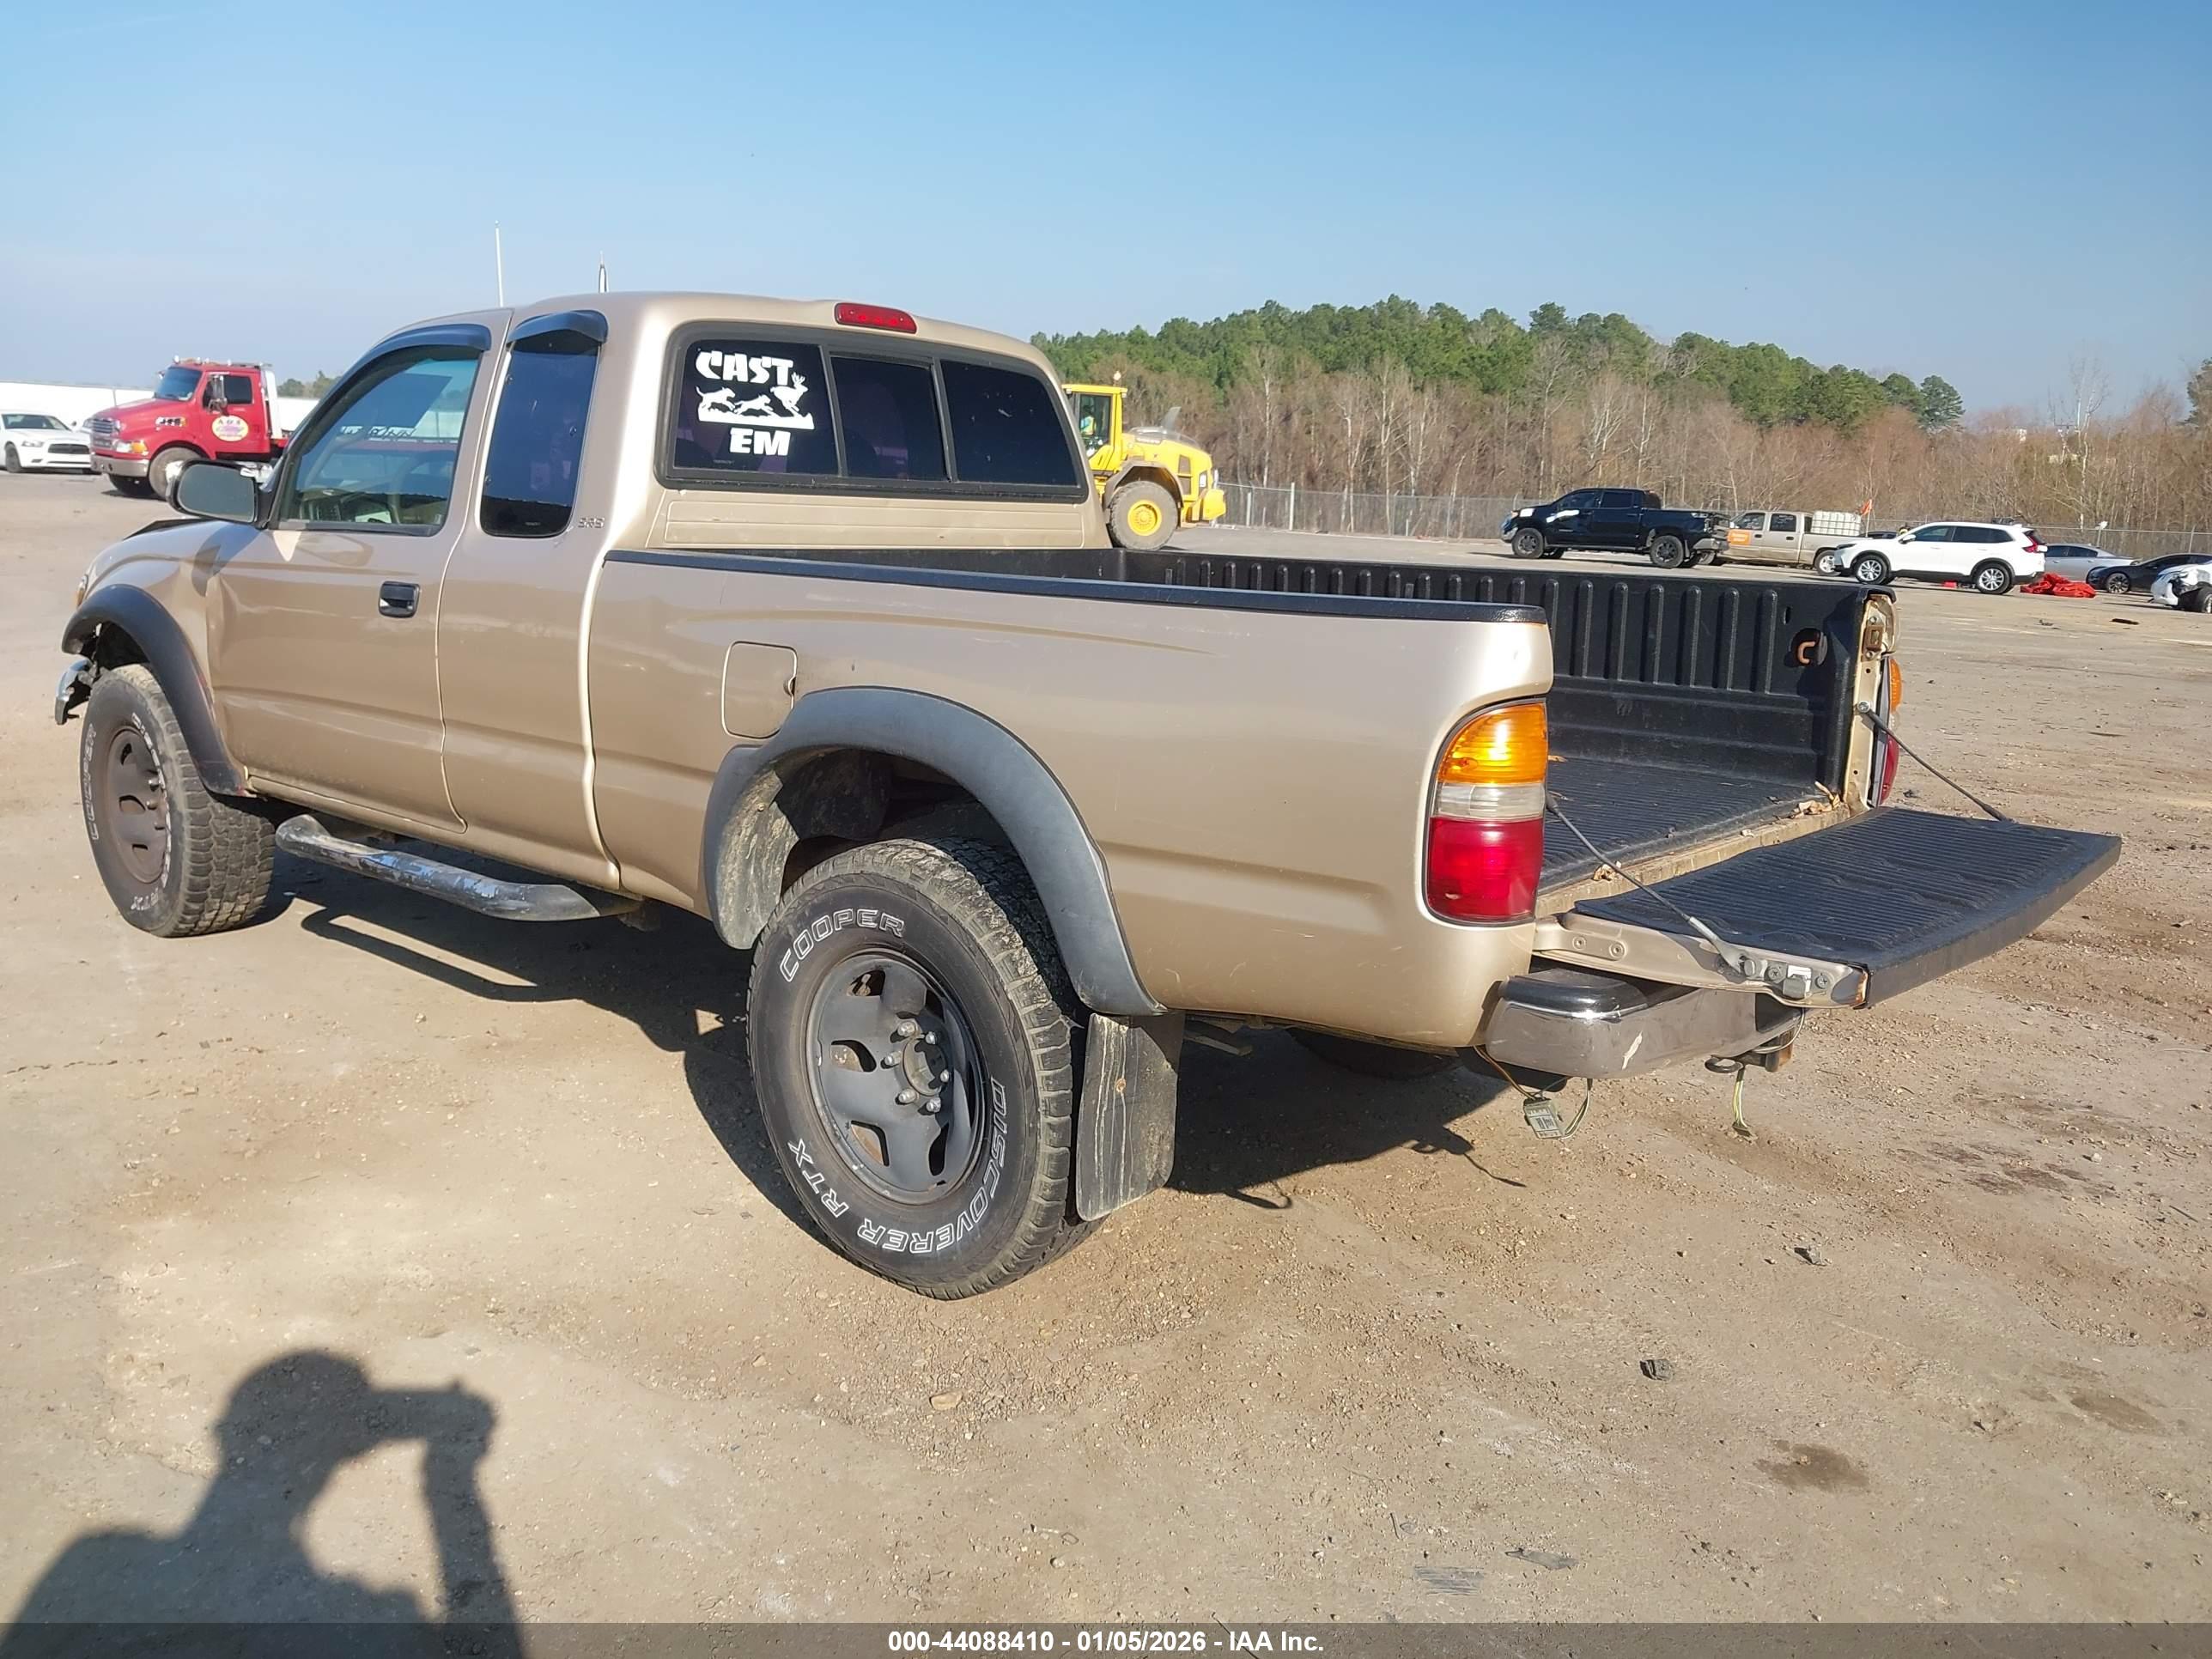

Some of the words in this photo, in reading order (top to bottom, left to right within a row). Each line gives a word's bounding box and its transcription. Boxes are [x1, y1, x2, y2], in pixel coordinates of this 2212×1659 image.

[696, 350, 793, 386] CAST
[730, 428, 791, 456] EM
[780, 908, 904, 981] COOPER
[787, 1138, 849, 1218] RTX
[857, 1075, 1008, 1254] DISCOVERER
